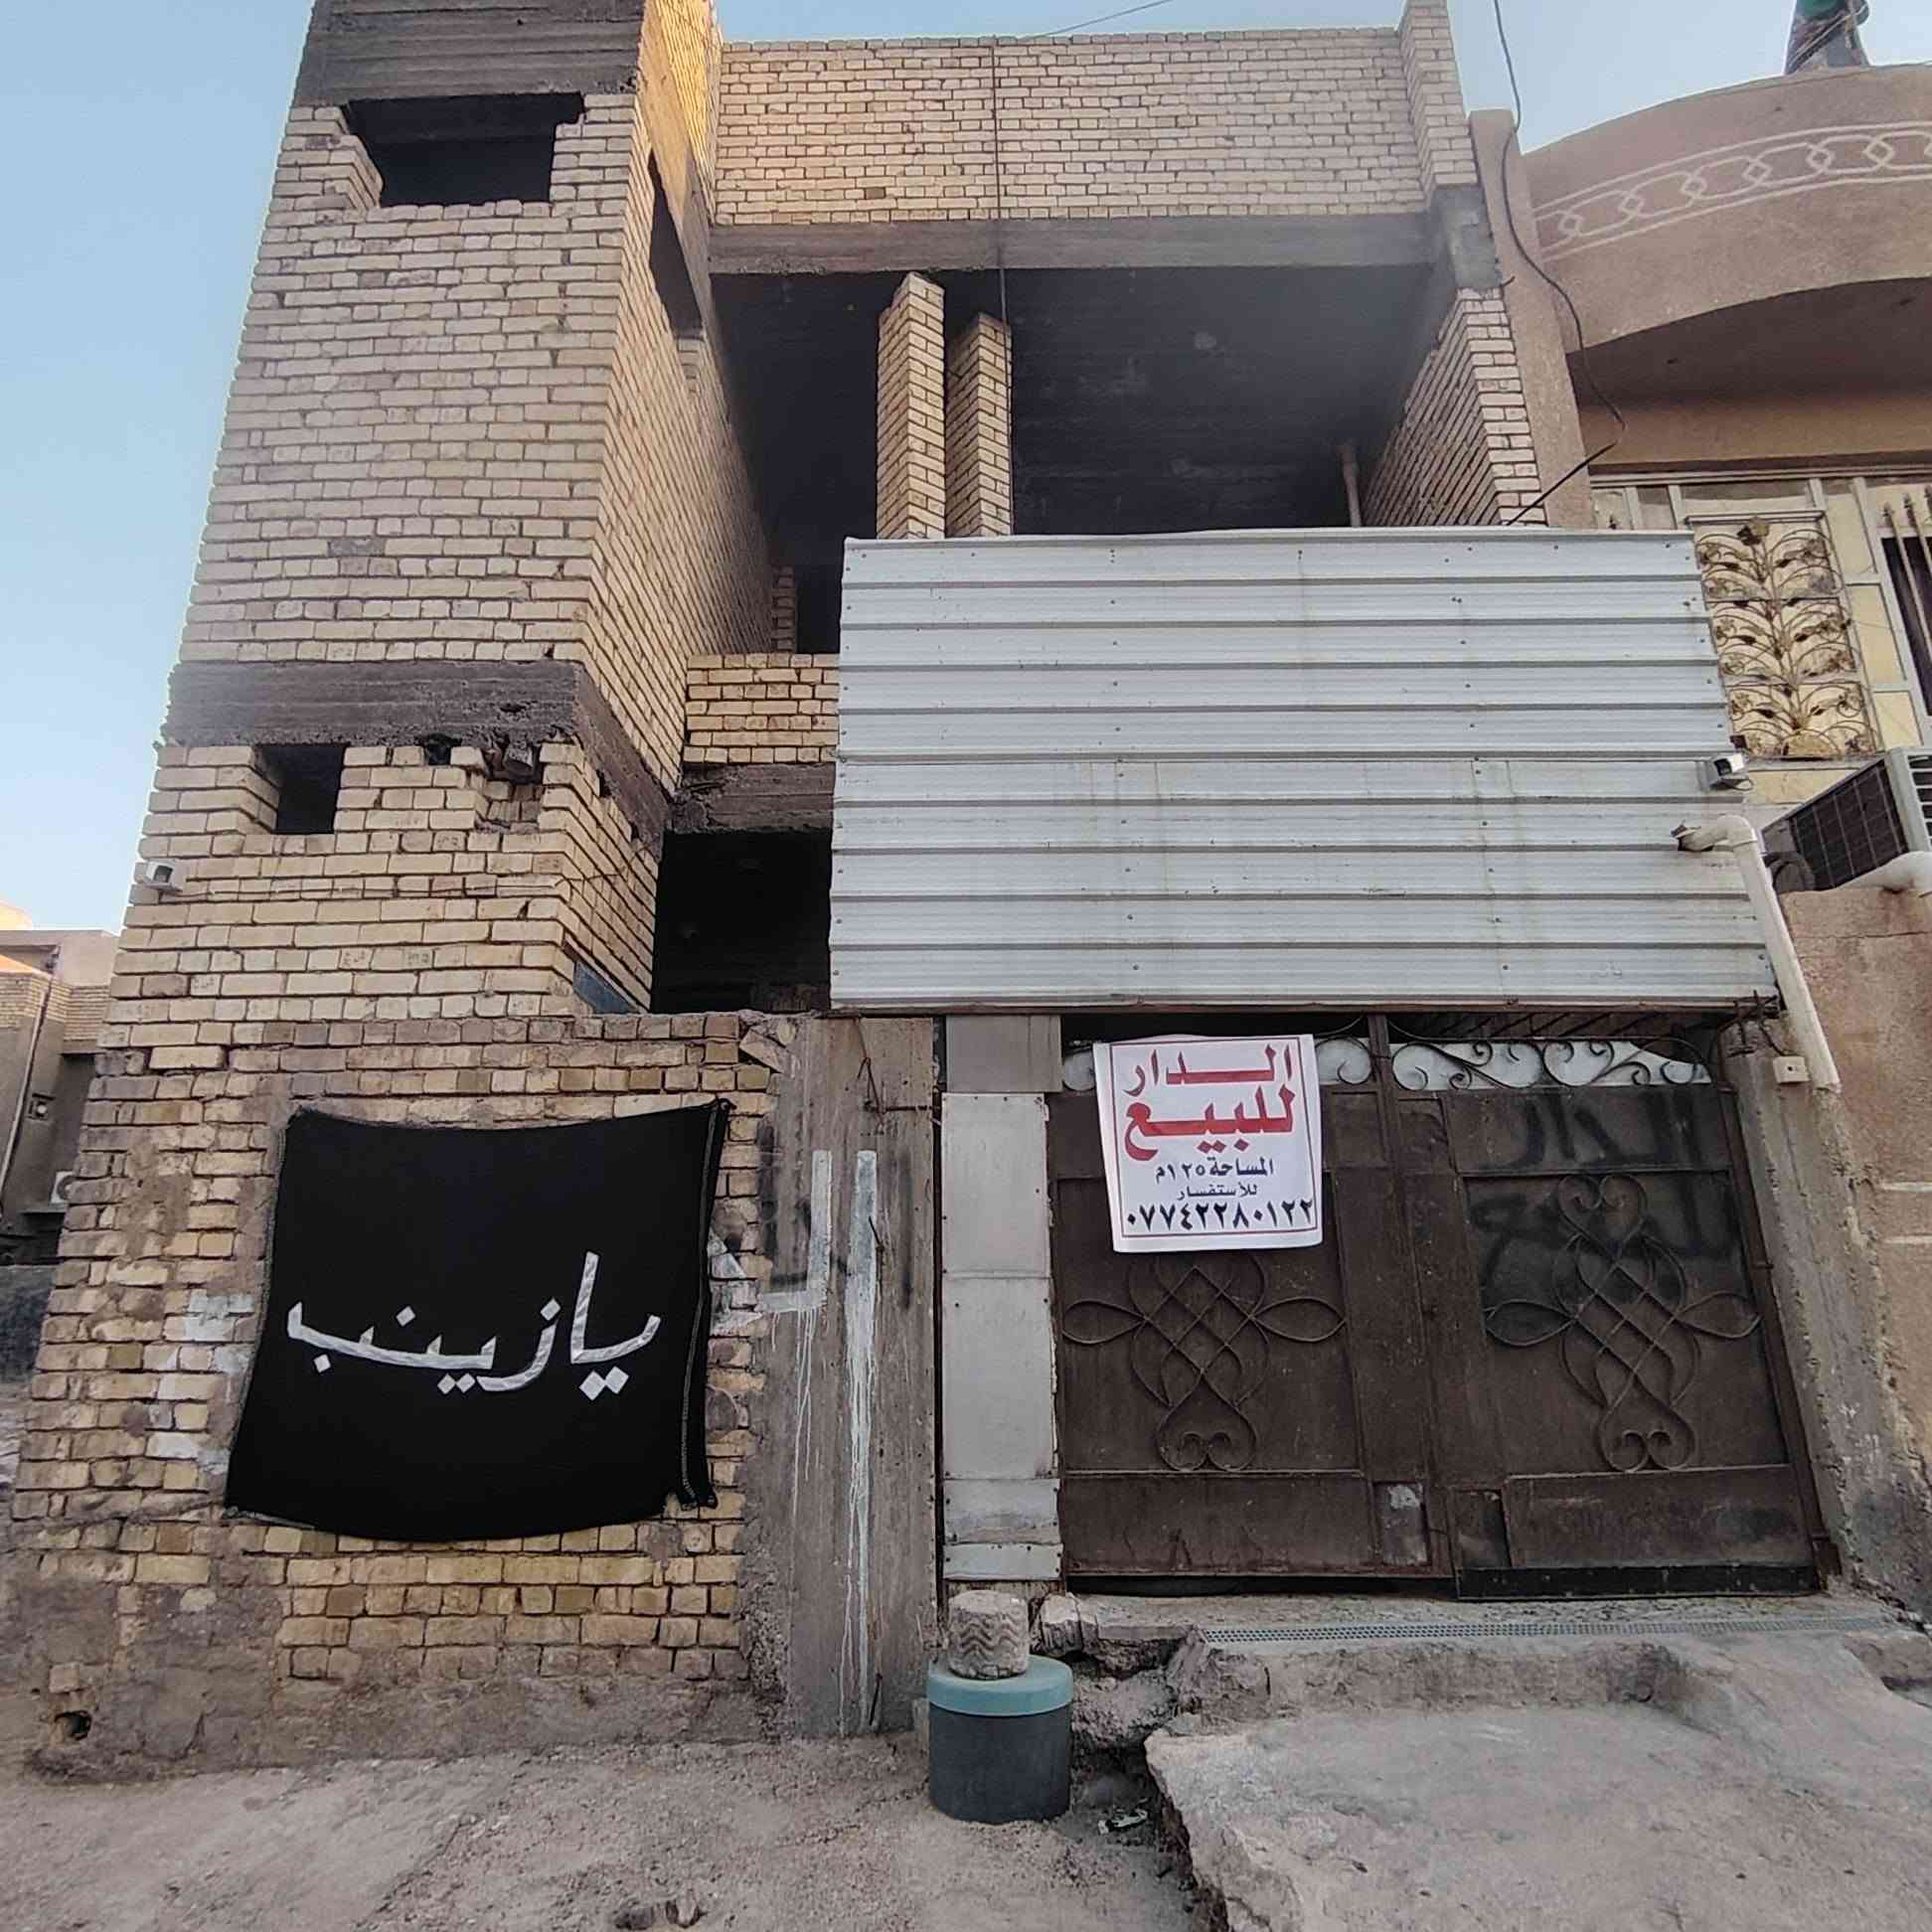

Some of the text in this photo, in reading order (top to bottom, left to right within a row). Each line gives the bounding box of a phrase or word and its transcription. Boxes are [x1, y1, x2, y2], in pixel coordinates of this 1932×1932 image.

[1123, 1044, 1293, 1098] الدار
[1124, 1083, 1296, 1162] للبيع
[1127, 1199, 1313, 1231] ٠٧٧٤٢٢٨٠١٢٢
